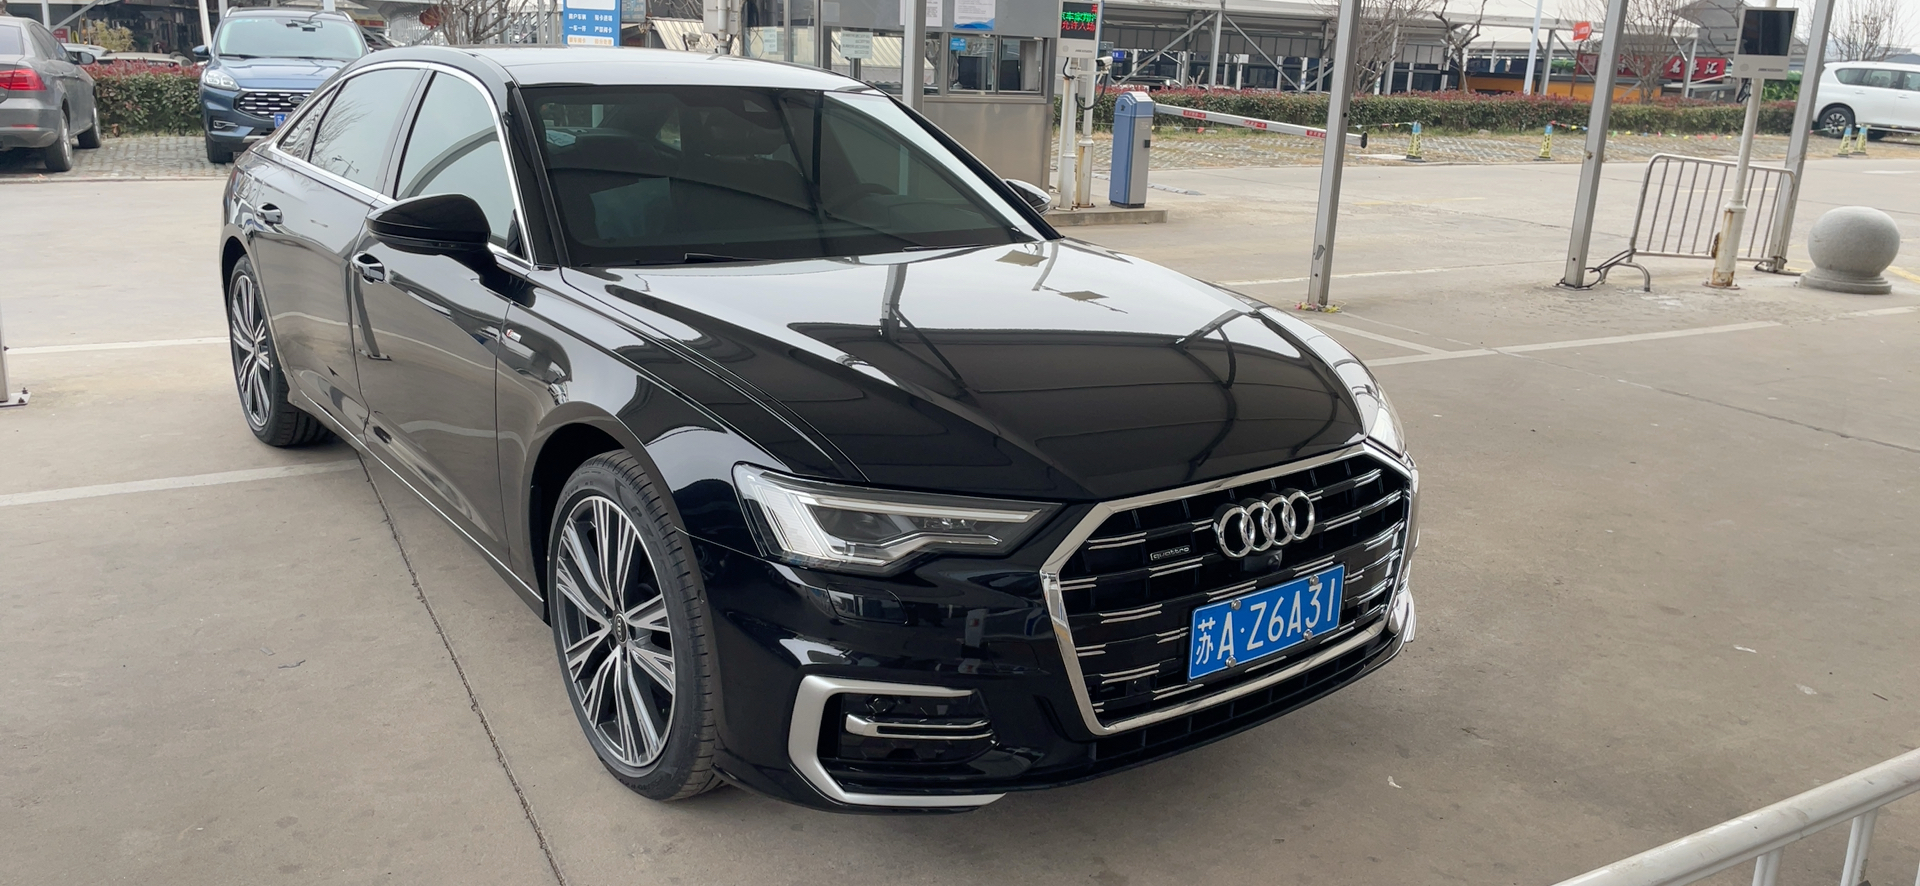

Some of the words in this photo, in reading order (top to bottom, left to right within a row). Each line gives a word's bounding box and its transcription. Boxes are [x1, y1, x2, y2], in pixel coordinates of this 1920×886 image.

[1061, 20, 1096, 31] 允许入场
[1152, 546, 1190, 560] quattro
